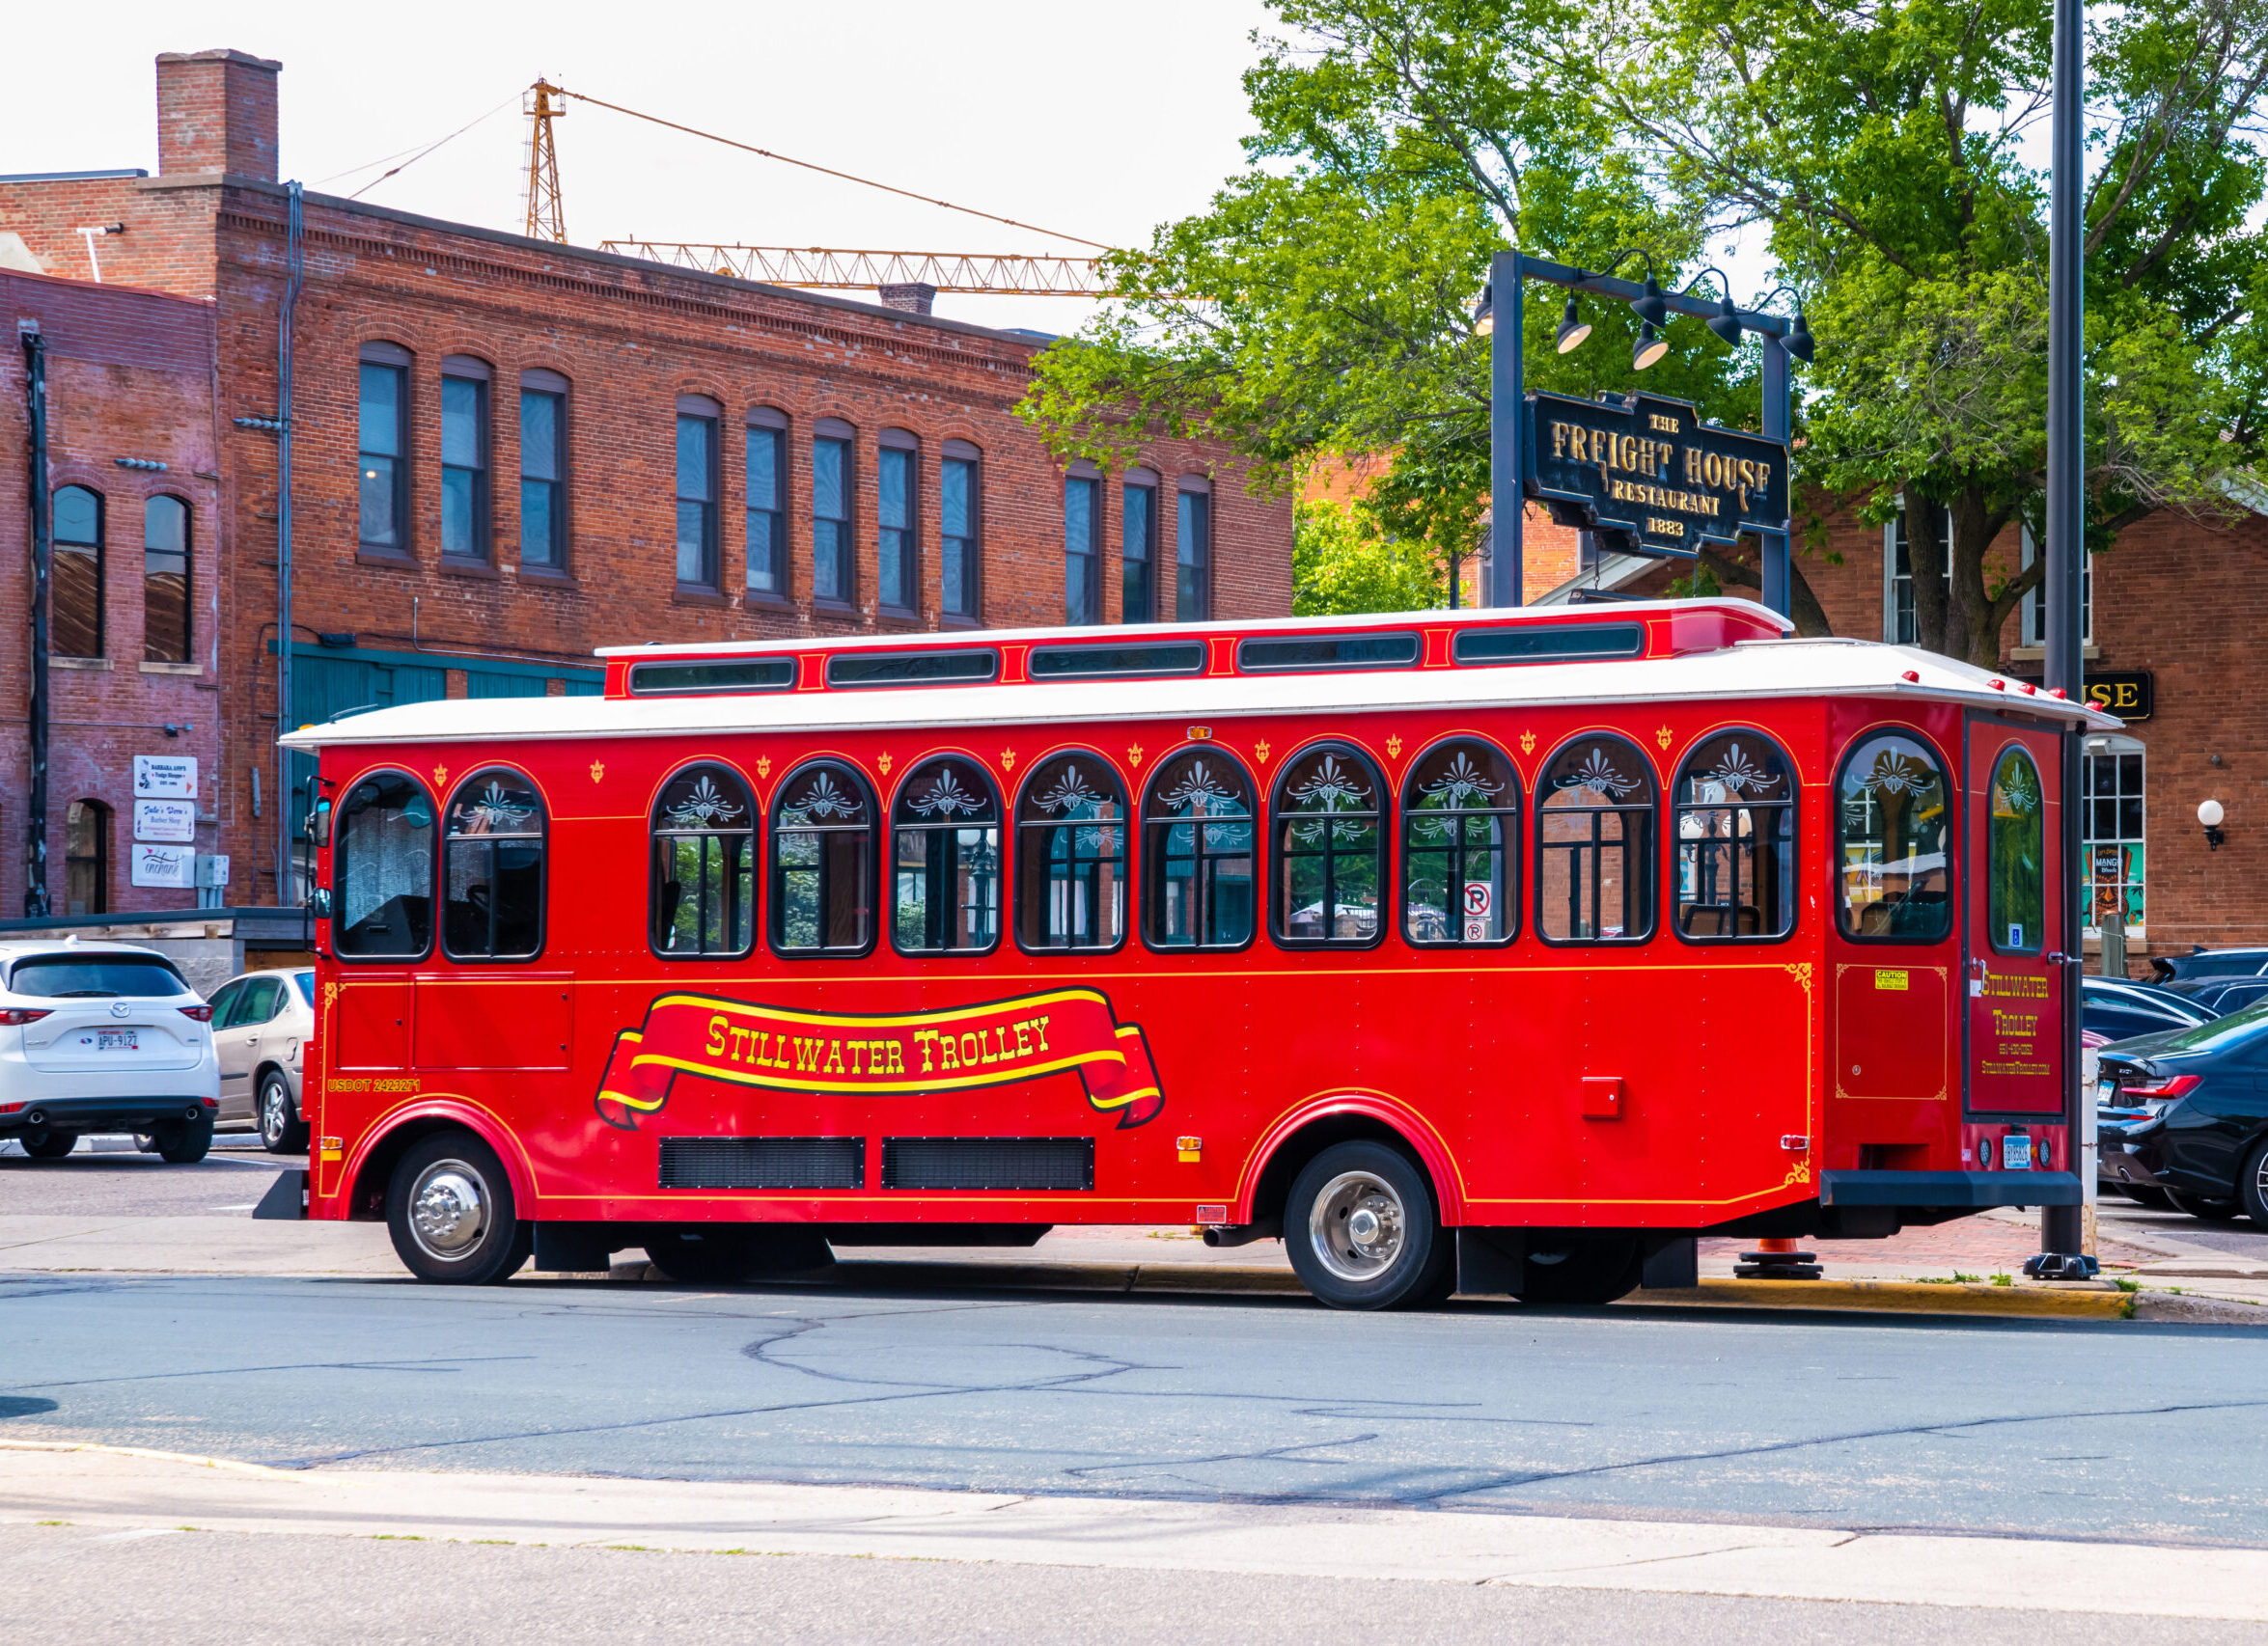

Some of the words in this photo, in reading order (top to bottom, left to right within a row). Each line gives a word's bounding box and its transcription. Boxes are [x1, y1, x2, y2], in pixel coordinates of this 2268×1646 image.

[1648, 414, 1679, 434] THE
[1550, 420, 1673, 482] FREIGHT
[1683, 447, 1771, 508] HOUSE
[1611, 480, 1720, 516] RESTAURANT
[1646, 517, 1684, 536] 1883
[328, 1079, 373, 1092] USDOT
[373, 1079, 421, 1092] 2423271
